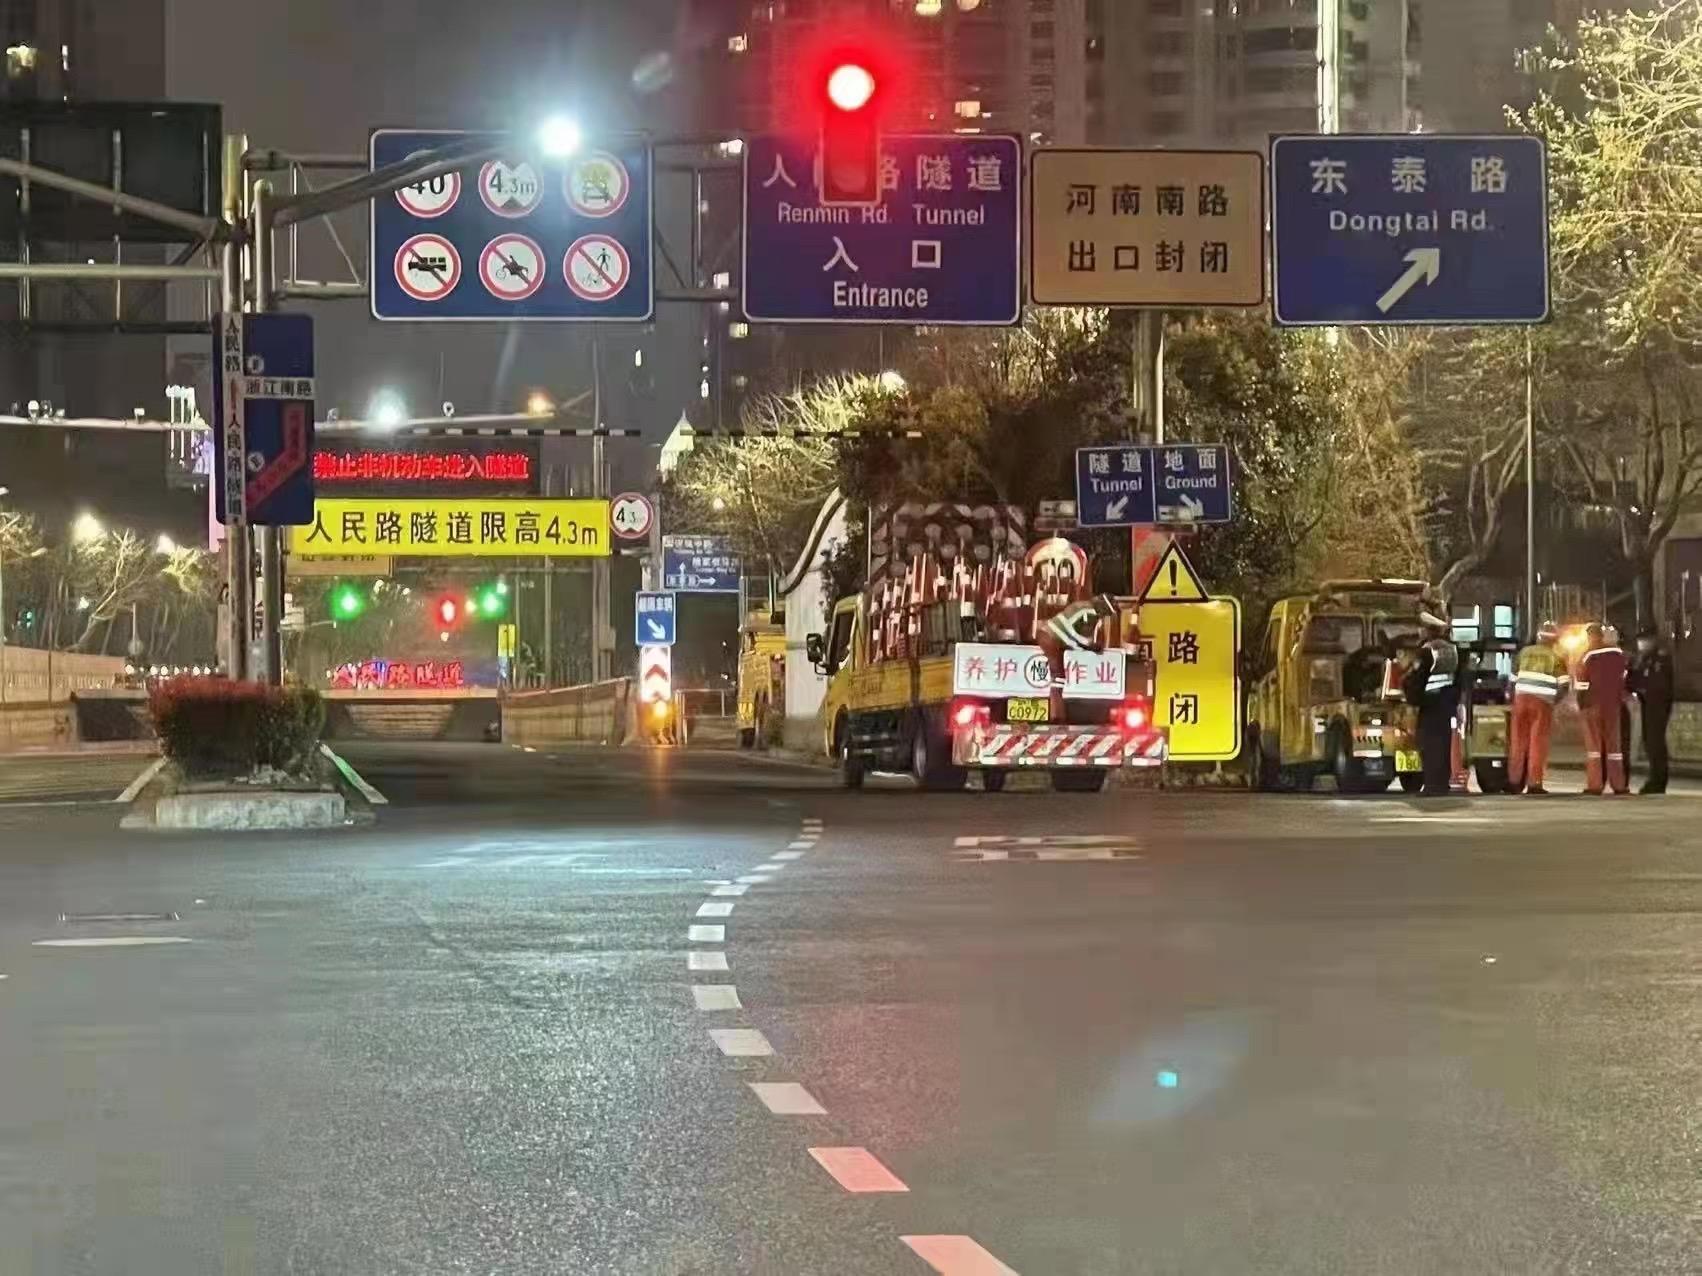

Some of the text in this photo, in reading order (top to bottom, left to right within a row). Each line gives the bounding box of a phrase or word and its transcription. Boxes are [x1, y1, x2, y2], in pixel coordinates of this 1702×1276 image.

[489, 168, 536, 194] 4.3m
[763, 153, 1002, 191] 人路隧道
[1309, 157, 1507, 194] 东泰路
[1066, 184, 1230, 216] 河南南路
[778, 202, 849, 223] Renmin
[912, 204, 985, 226] Tunnel
[1329, 210, 1438, 236] Dongtai
[823, 236, 942, 272] 入口
[1068, 239, 1228, 273] 出口封闭
[833, 281, 929, 308] Entrance
[1088, 452, 1143, 475] 隧道
[1163, 448, 1217, 472] 地面
[1091, 477, 1143, 494] Tunnel
[1165, 475, 1217, 490] Ground
[304, 510, 599, 546] 人民路隧道限高4.3m
